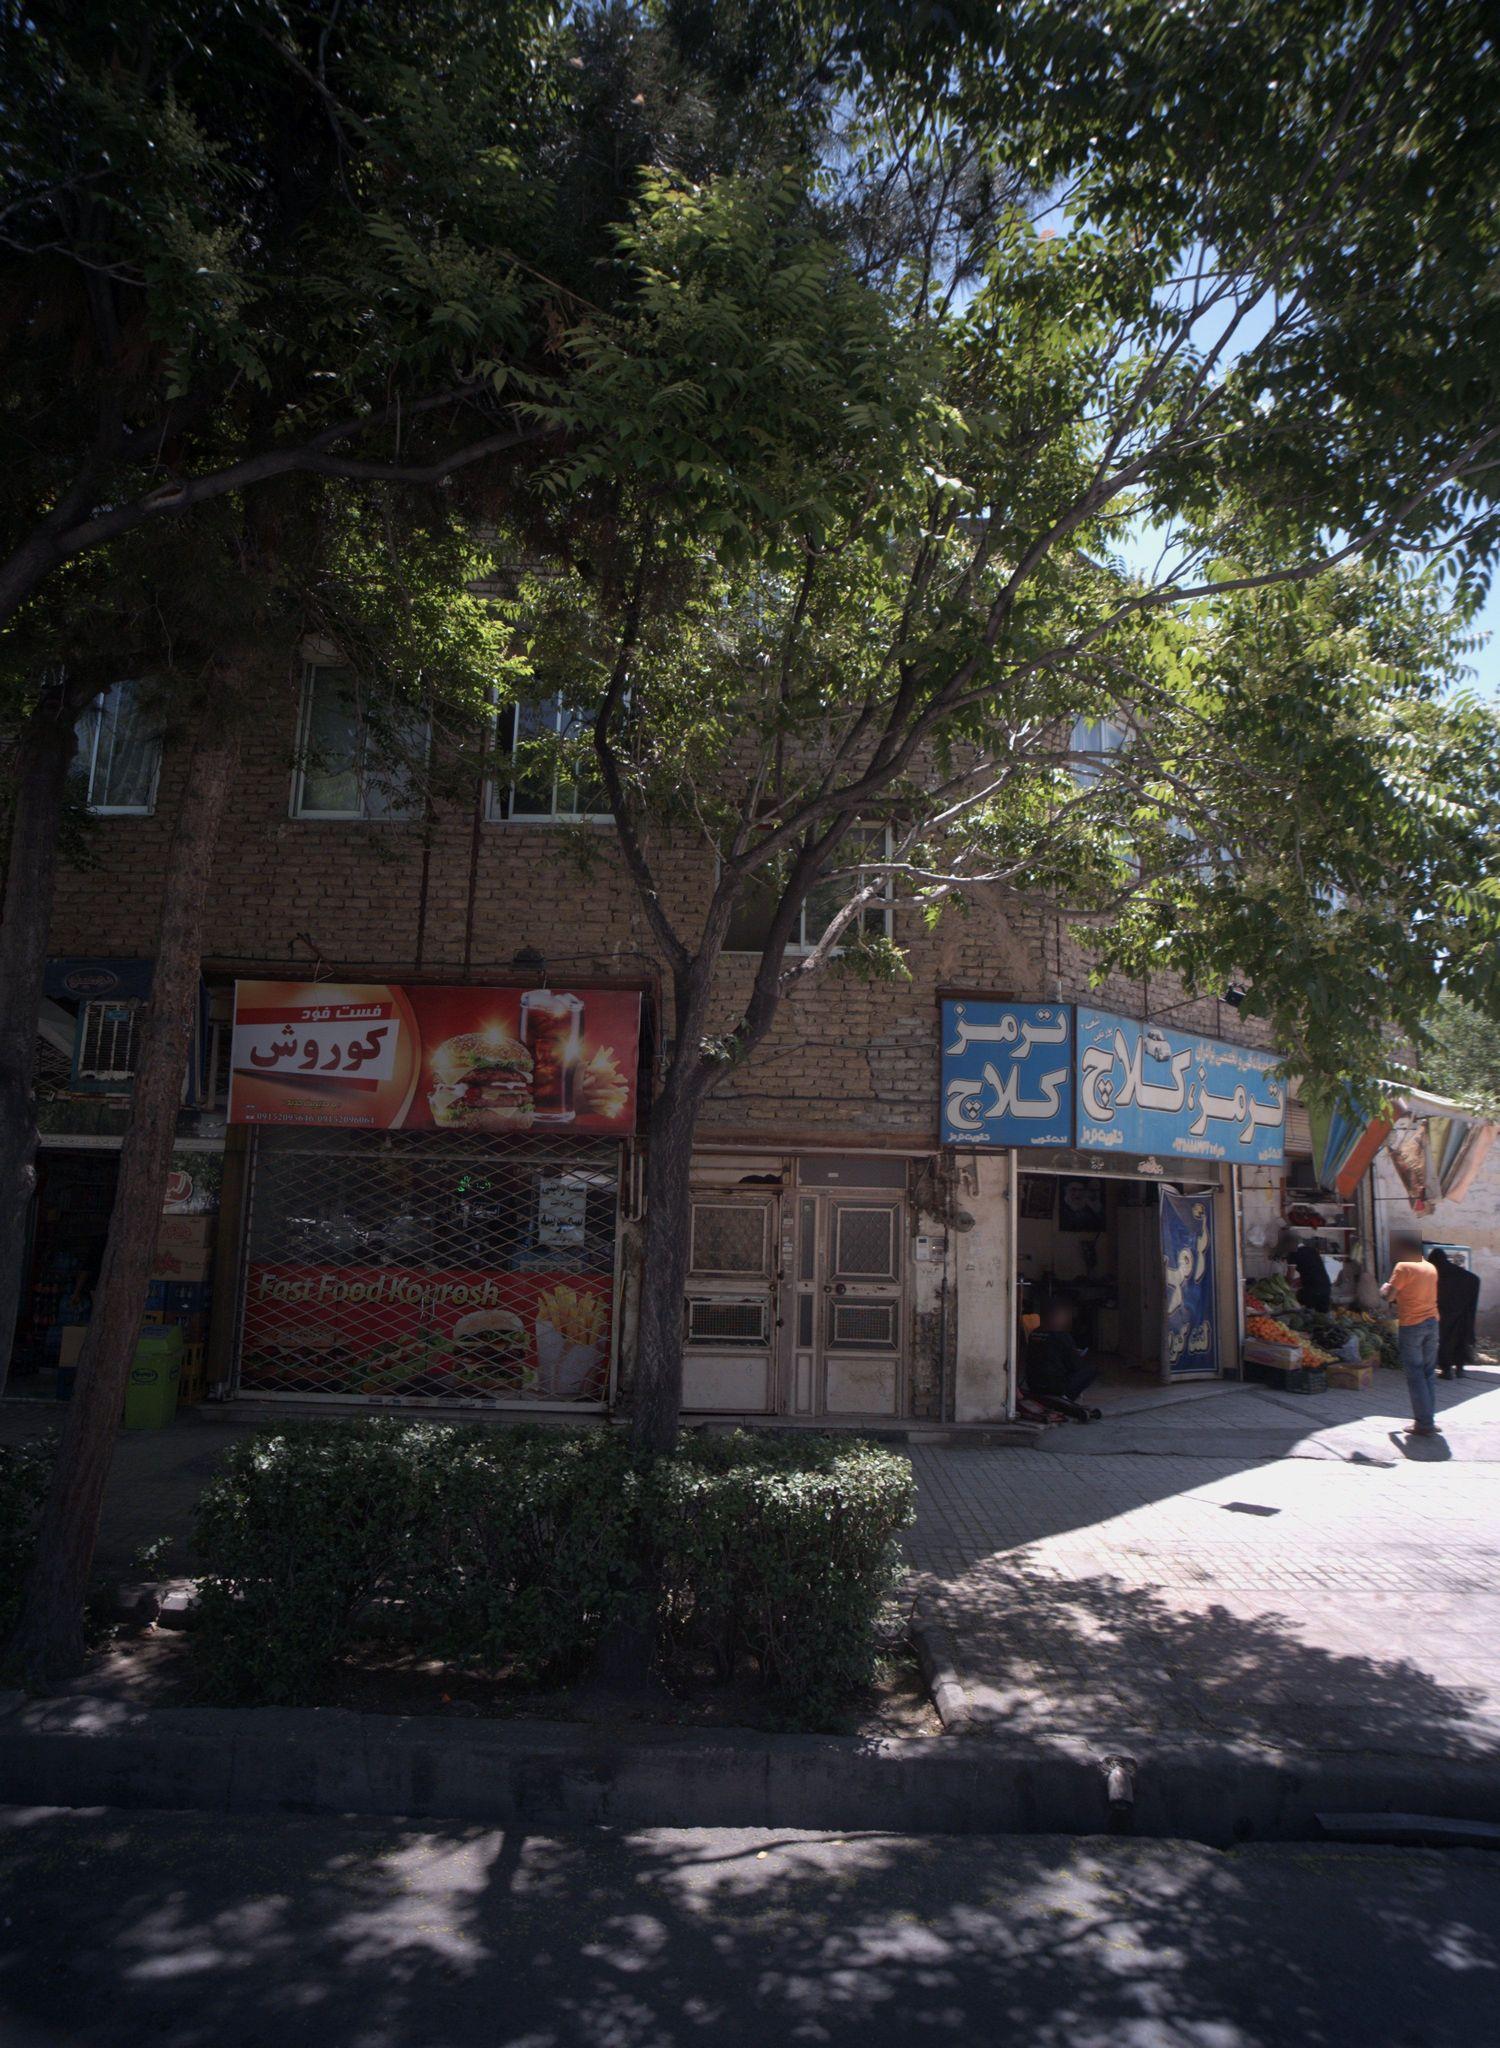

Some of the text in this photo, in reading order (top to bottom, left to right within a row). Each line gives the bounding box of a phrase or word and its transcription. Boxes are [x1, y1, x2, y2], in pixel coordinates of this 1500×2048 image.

[301, 1005, 382, 1021] فست فود
[945, 1003, 1068, 1059] ترمز
[250, 1024, 388, 1071] کوروش
[945, 1062, 1070, 1131] کلاچ
[1081, 1027, 1193, 1123] کلاچ
[260, 1272, 499, 1306] Fast Food Kourosh
